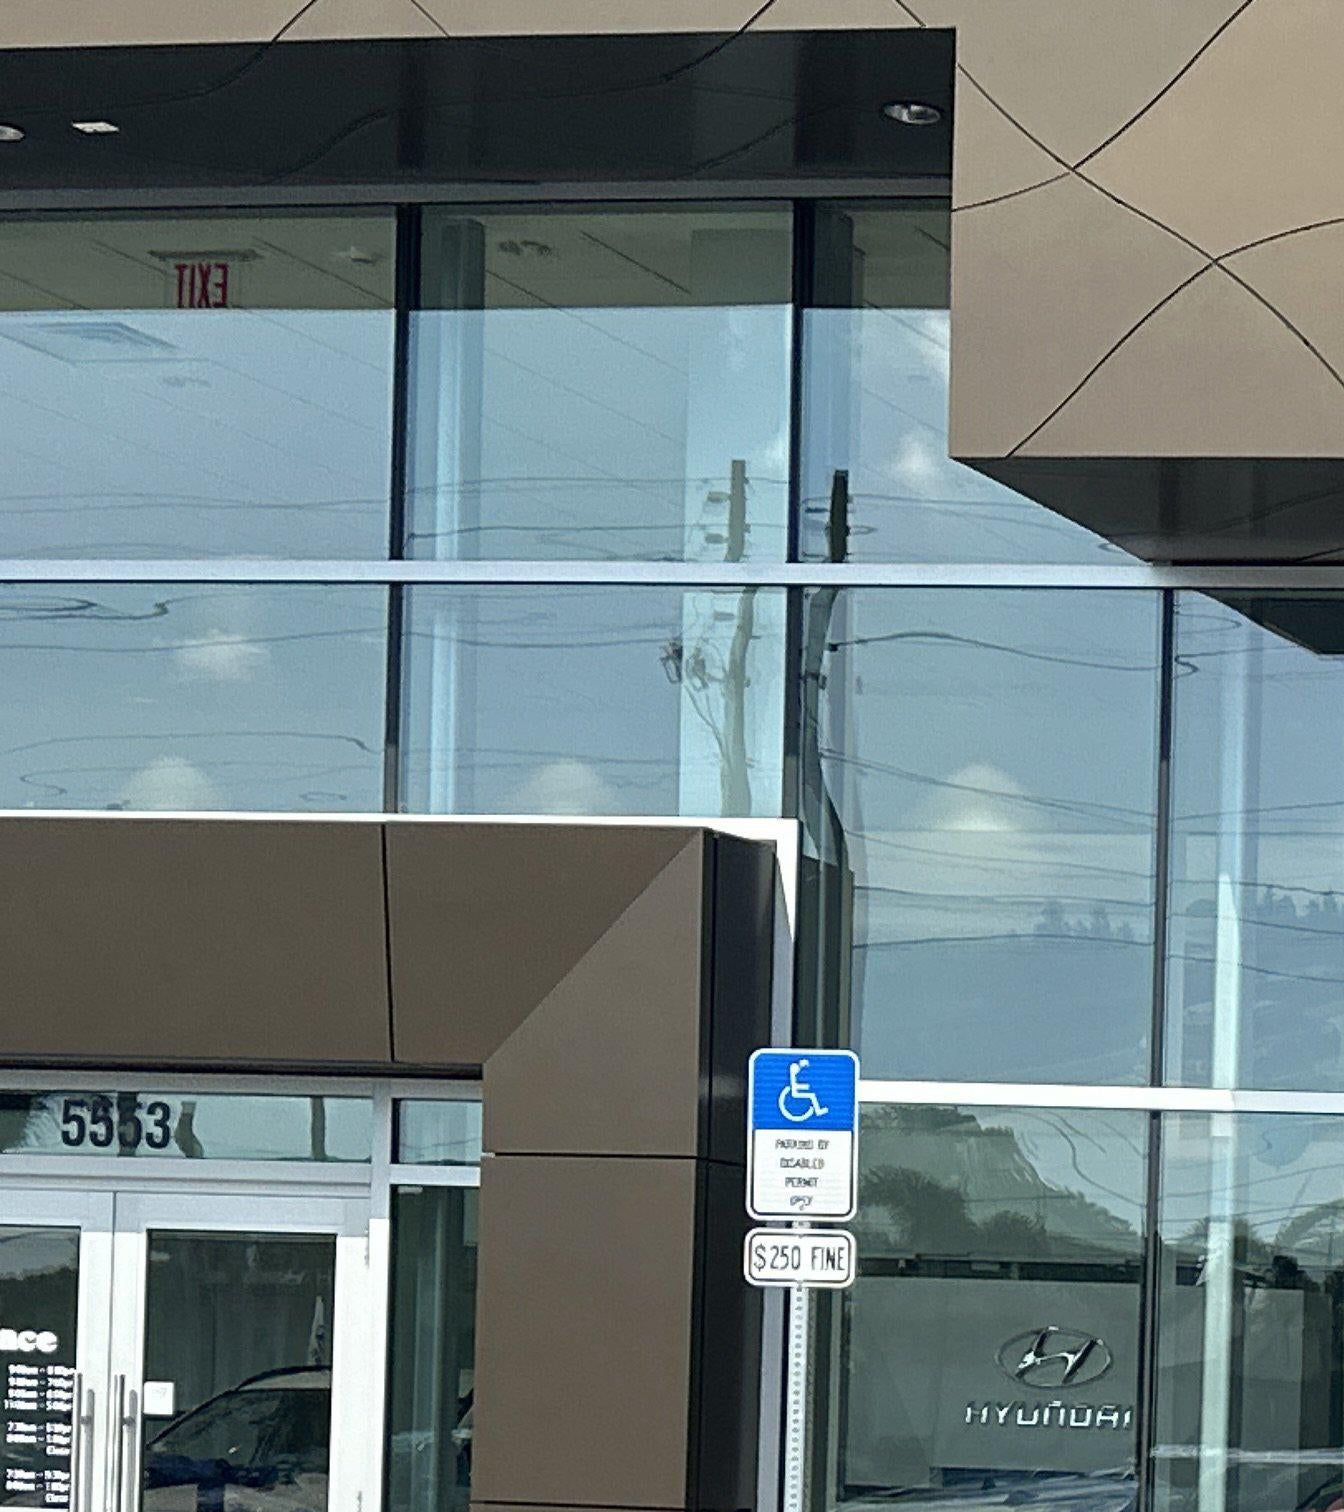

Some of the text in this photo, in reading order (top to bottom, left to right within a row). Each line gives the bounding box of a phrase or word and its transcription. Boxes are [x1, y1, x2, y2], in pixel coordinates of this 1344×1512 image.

[60, 1095, 171, 1149] 5553
[754, 1243, 846, 1273] $250 FINE
[965, 1400, 1133, 1431] HYUNDAI
